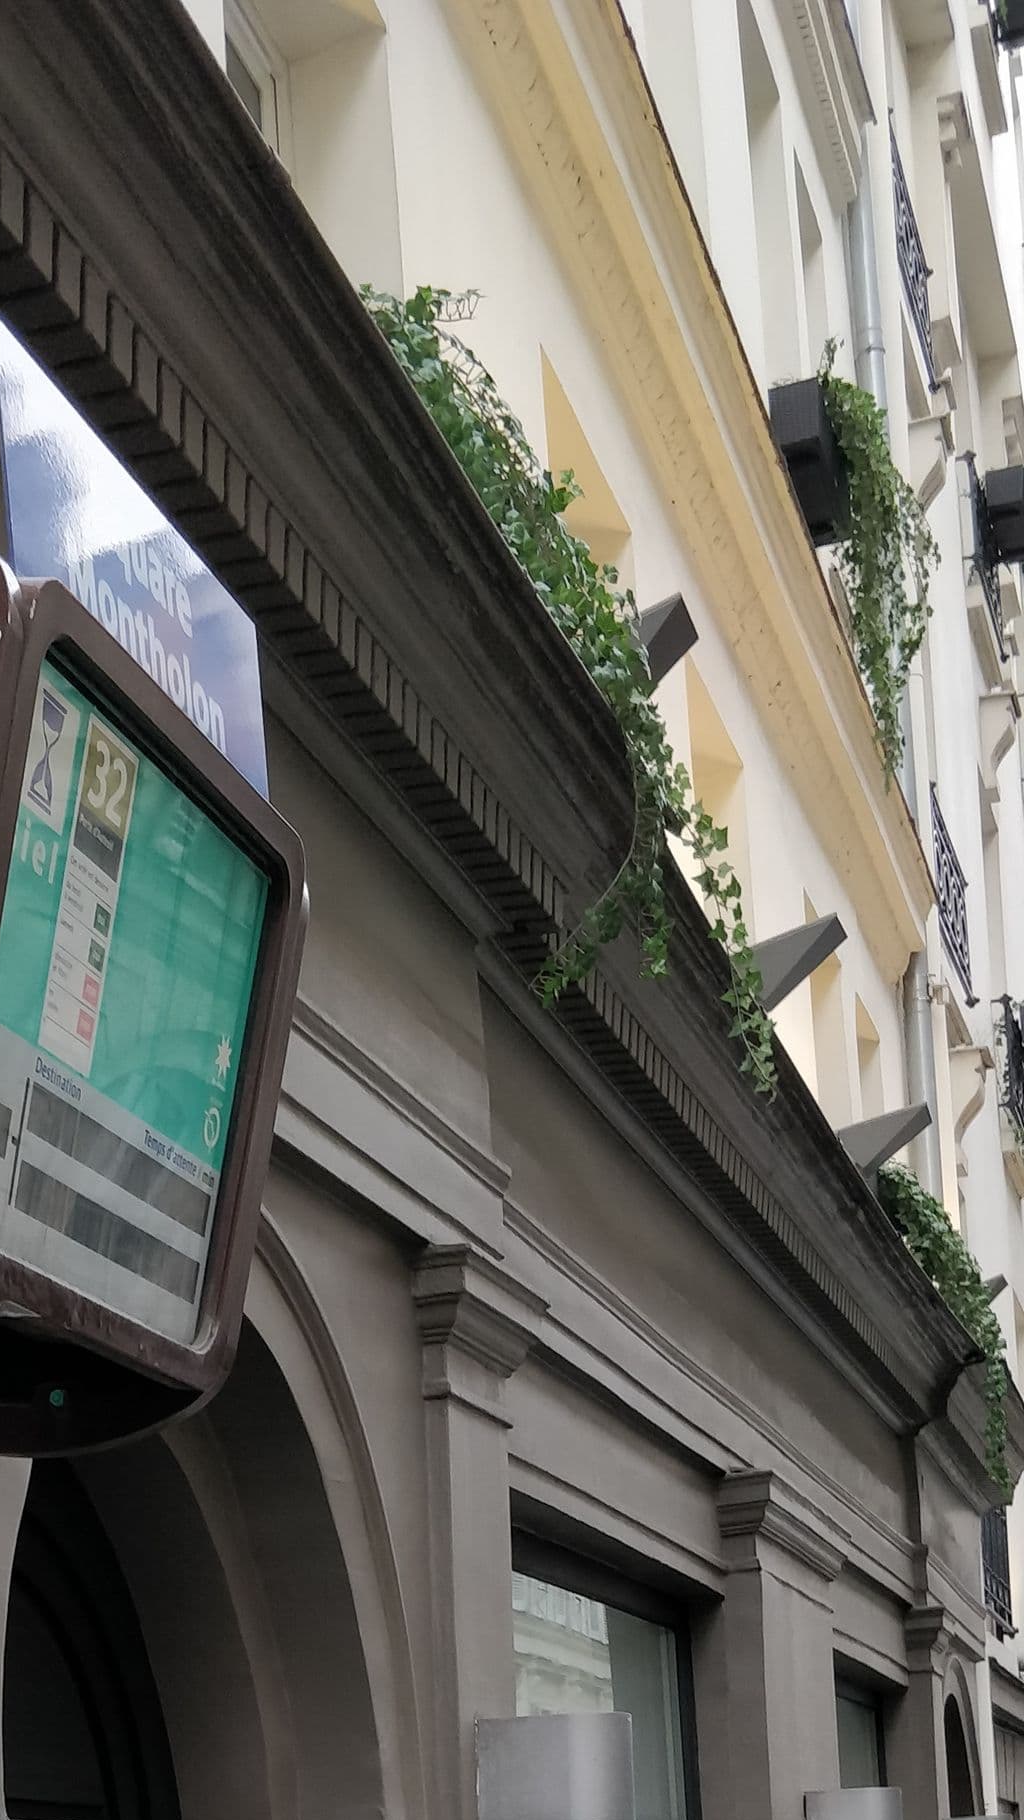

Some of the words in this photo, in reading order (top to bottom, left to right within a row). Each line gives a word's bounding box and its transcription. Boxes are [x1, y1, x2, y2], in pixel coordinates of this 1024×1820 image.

[87, 739, 128, 828] 32
[35, 1056, 82, 1101] Destination
[144, 1129, 166, 1156] Temps
